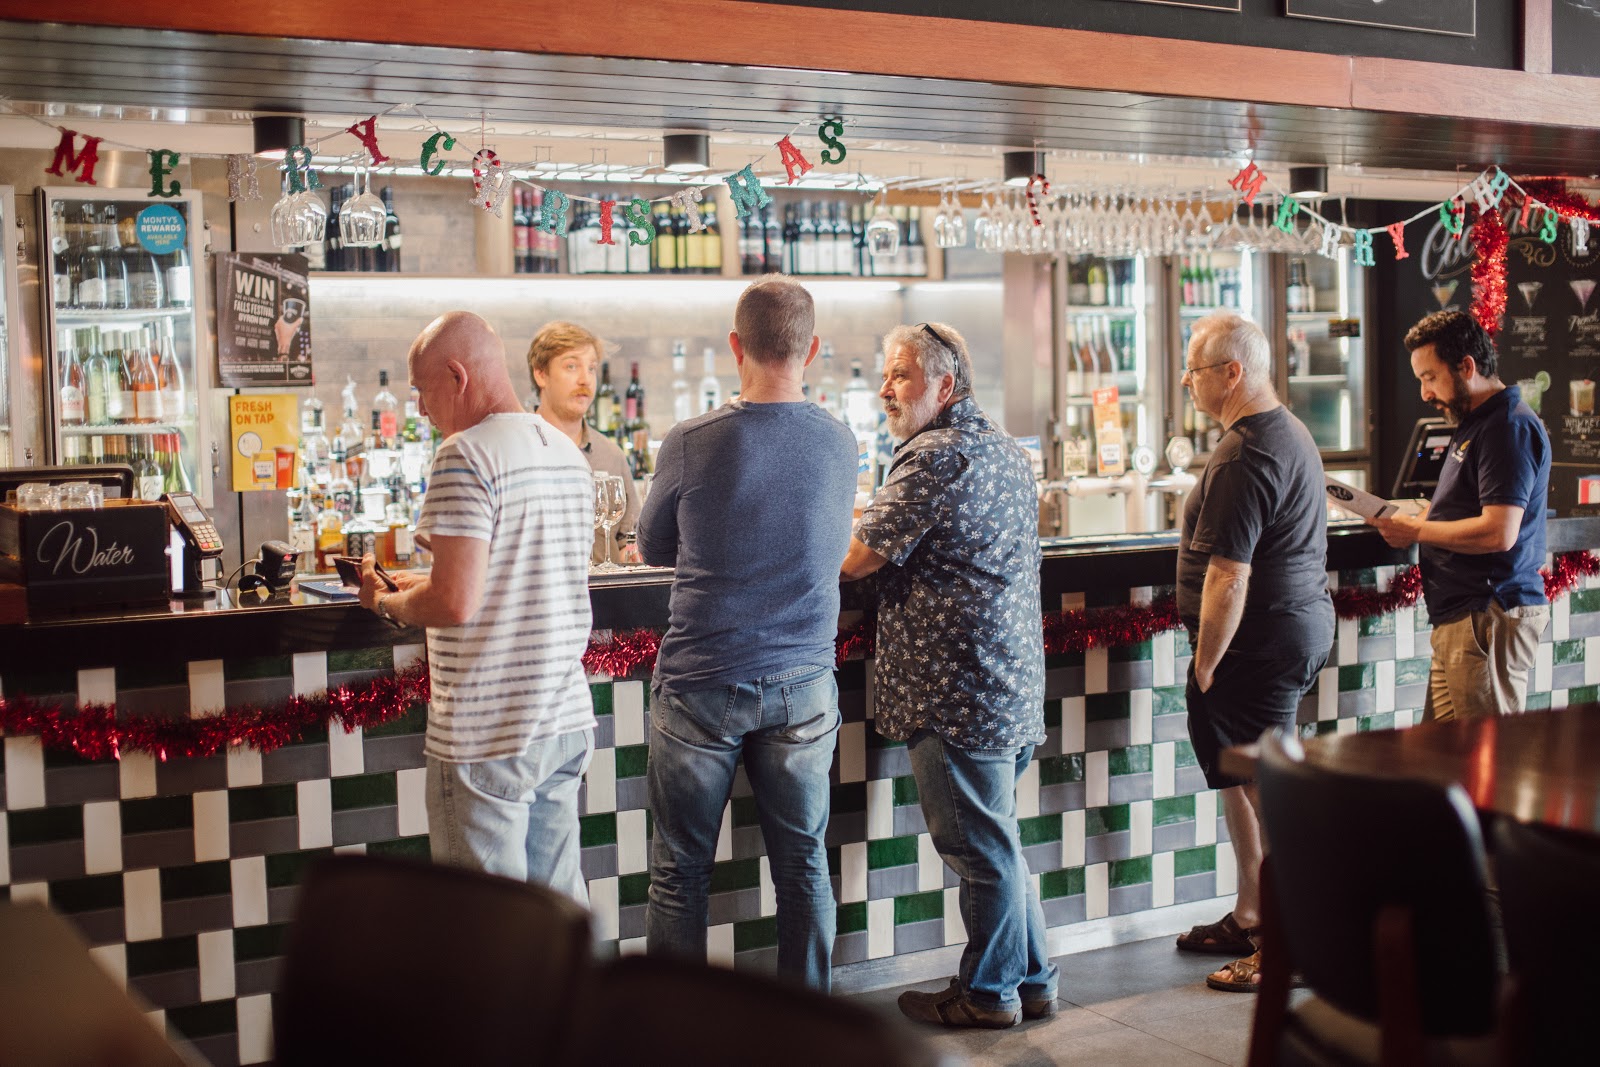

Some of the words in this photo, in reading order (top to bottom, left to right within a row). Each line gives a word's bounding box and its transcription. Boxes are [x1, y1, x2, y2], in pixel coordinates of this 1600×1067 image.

[45, 115, 391, 202] MERRY
[420, 117, 847, 247] CHRISTMAS
[143, 216, 178, 224] MONTY'S
[1228, 160, 1410, 267] MERRY
[141, 224, 181, 232] REWARDS
[235, 270, 274, 301] WIN
[234, 299, 250, 313] FALLS
[250, 303, 274, 318] FESTIVAL
[238, 313, 258, 324] BYRON
[259, 317, 269, 326] BAY
[235, 401, 272, 412] FRESH
[236, 414, 252, 425] ON
[254, 413, 275, 424] TAP
[36, 520, 135, 576] Water
